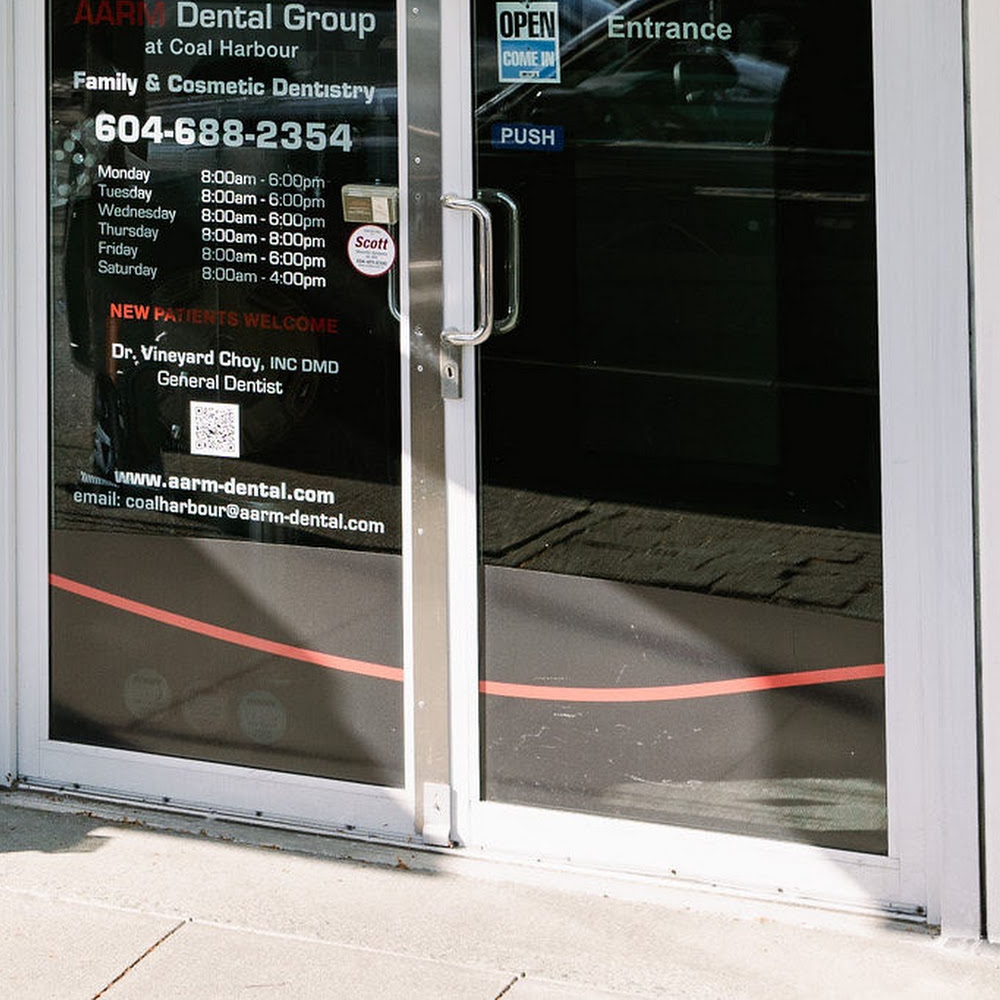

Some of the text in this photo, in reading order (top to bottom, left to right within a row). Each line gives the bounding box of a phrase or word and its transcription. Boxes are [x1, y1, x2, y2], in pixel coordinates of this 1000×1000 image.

[73, 0, 377, 39] AARM Dental Group
[500, 10, 555, 39] OPEN
[607, 14, 733, 41] Entrance
[145, 38, 299, 59] at Coal Harbour
[503, 50, 555, 67] COME IN
[73, 71, 376, 104] Family & Cosmetic Dentistry
[95, 114, 353, 152] 604-688-2354
[500, 127, 555, 146] PUSH
[98, 165, 150, 183] Monday
[201, 169, 257, 187] 8:00am
[268, 173, 325, 191] 6:00pm
[98, 184, 152, 202] Tuesday
[201, 189, 257, 206] 8:00am
[268, 192, 325, 210] 6:00pm
[98, 203, 176, 223] Wednesday
[201, 208, 257, 225] 8:00am
[268, 211, 325, 229] 6:00pm
[98, 222, 159, 241] Thursday
[201, 227, 257, 245] 8:00am
[268, 231, 326, 249] 8:00pm
[354, 235, 389, 251] Scott
[98, 241, 138, 259] Friday
[201, 247, 257, 264] 8:00am
[269, 250, 326, 269] 6:00pm
[98, 260, 158, 281] Saturday
[201, 266, 257, 284] 8:00am
[269, 270, 326, 289] 4:00pm
[110, 303, 339, 334] NEW PATIENTS WELCOME
[112, 343, 339, 374] Dr. Vineyard Choy, INC DMD
[157, 370, 283, 395] General Dentist
[114, 470, 335, 504] www.aarm-dental.com
[73, 490, 385, 534] email: coalharbour@aarm-dental.com
